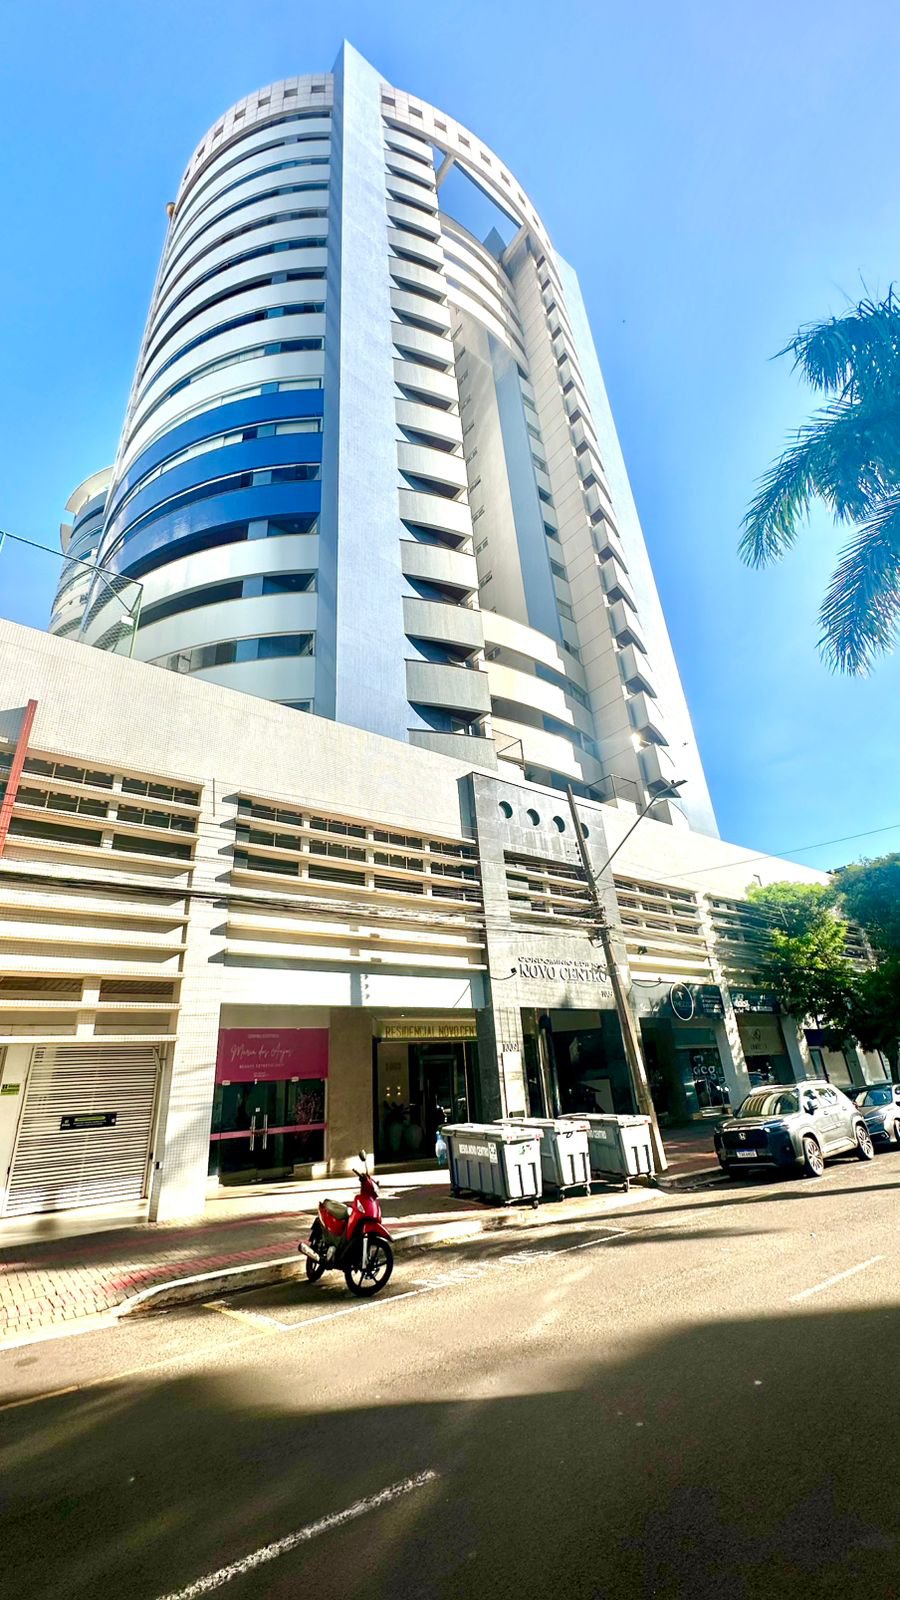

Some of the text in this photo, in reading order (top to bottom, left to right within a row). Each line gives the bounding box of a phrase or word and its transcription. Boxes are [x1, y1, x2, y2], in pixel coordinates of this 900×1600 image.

[519, 963, 607, 983] NOVO CENTRO
[385, 1025, 475, 1038] RESIDENCIAL NOVO CEN
